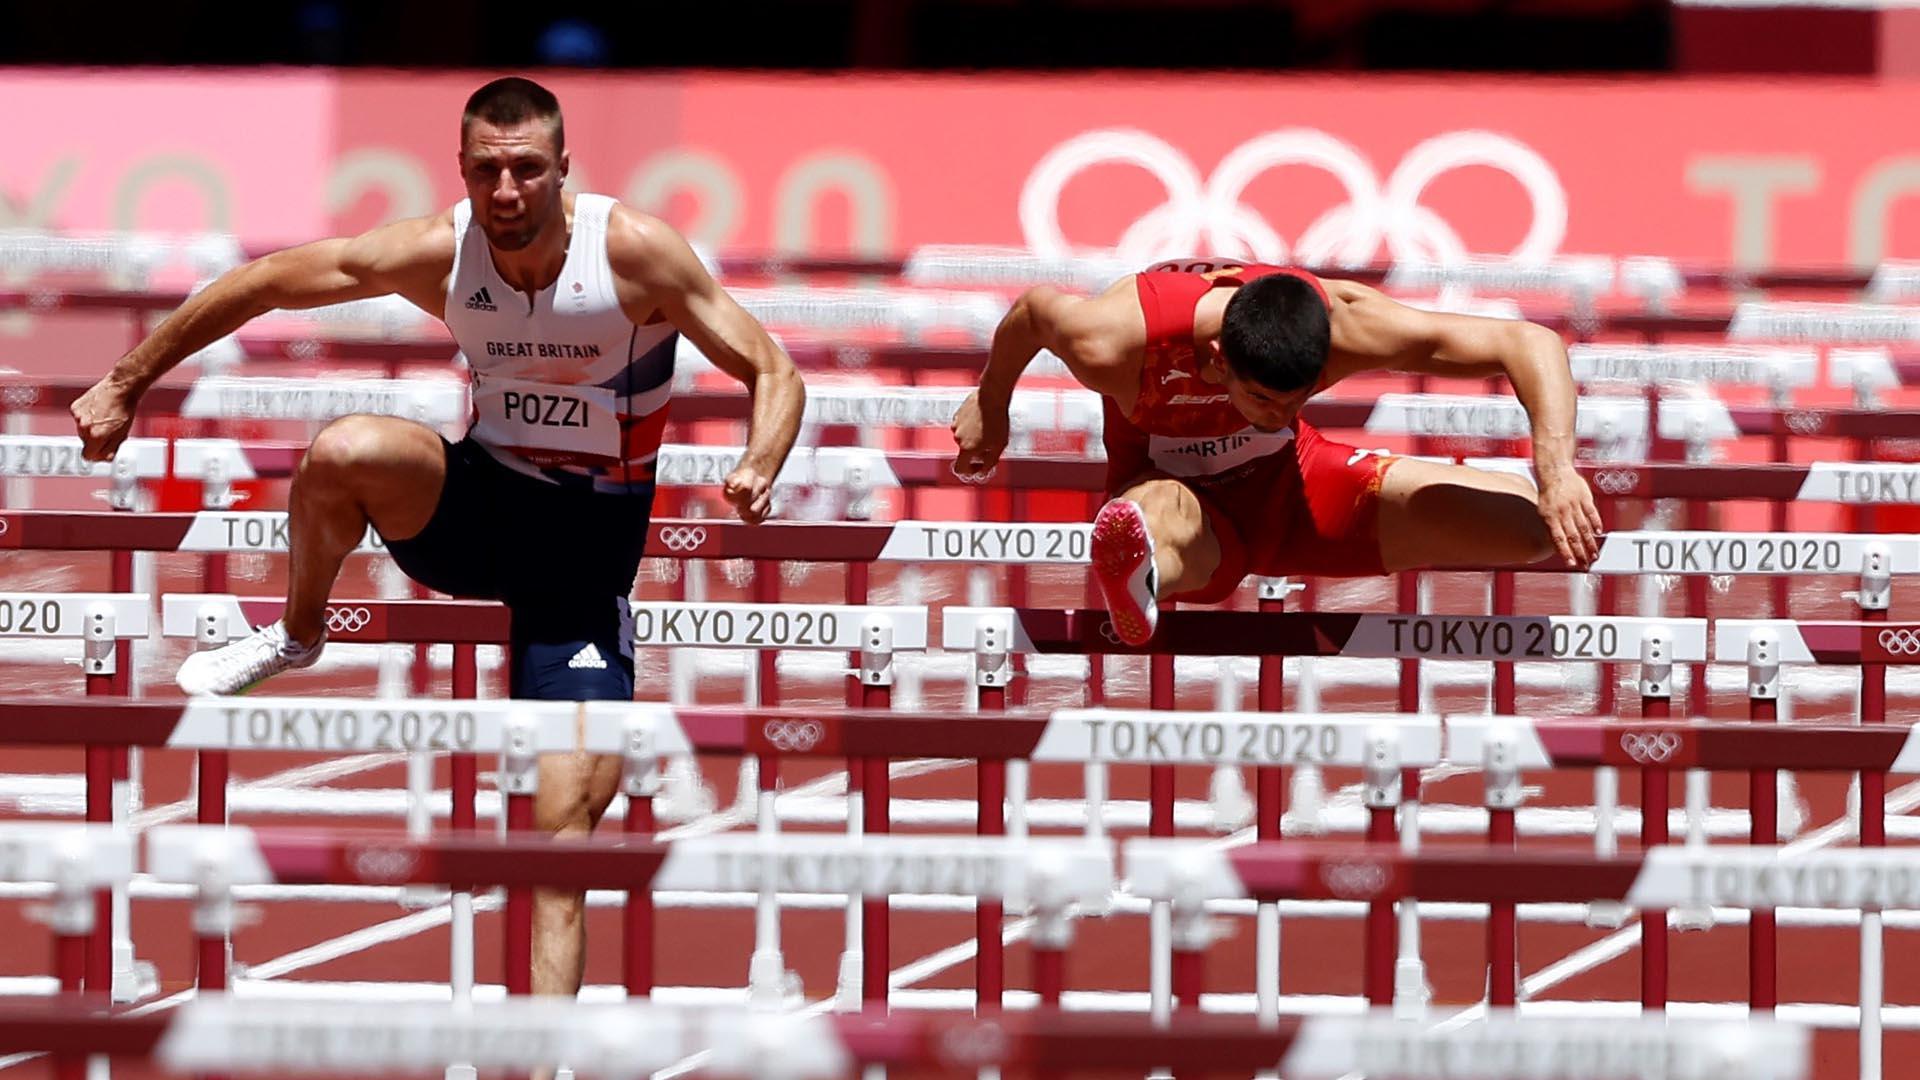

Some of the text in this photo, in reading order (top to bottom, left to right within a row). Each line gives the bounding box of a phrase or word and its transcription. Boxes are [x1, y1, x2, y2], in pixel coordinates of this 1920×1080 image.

[464, 301, 498, 313] adidas
[486, 341, 601, 360] GREAT BRITAIN
[504, 391, 589, 428] POZZI
[1167, 393, 1232, 405] ESP
[1833, 471, 1920, 501] TOKY
[222, 517, 290, 548] TOK
[921, 528, 1086, 559] TOKYO 20
[1632, 539, 1842, 571] TOKYO 2020
[0, 599, 61, 633] 020
[633, 608, 838, 645] OKYO 2020
[1387, 618, 1618, 657] TOKYO 2020
[568, 659, 608, 669] adidas
[220, 708, 477, 751] TOKYO 2020
[1083, 720, 1341, 762] TOKYO 2020
